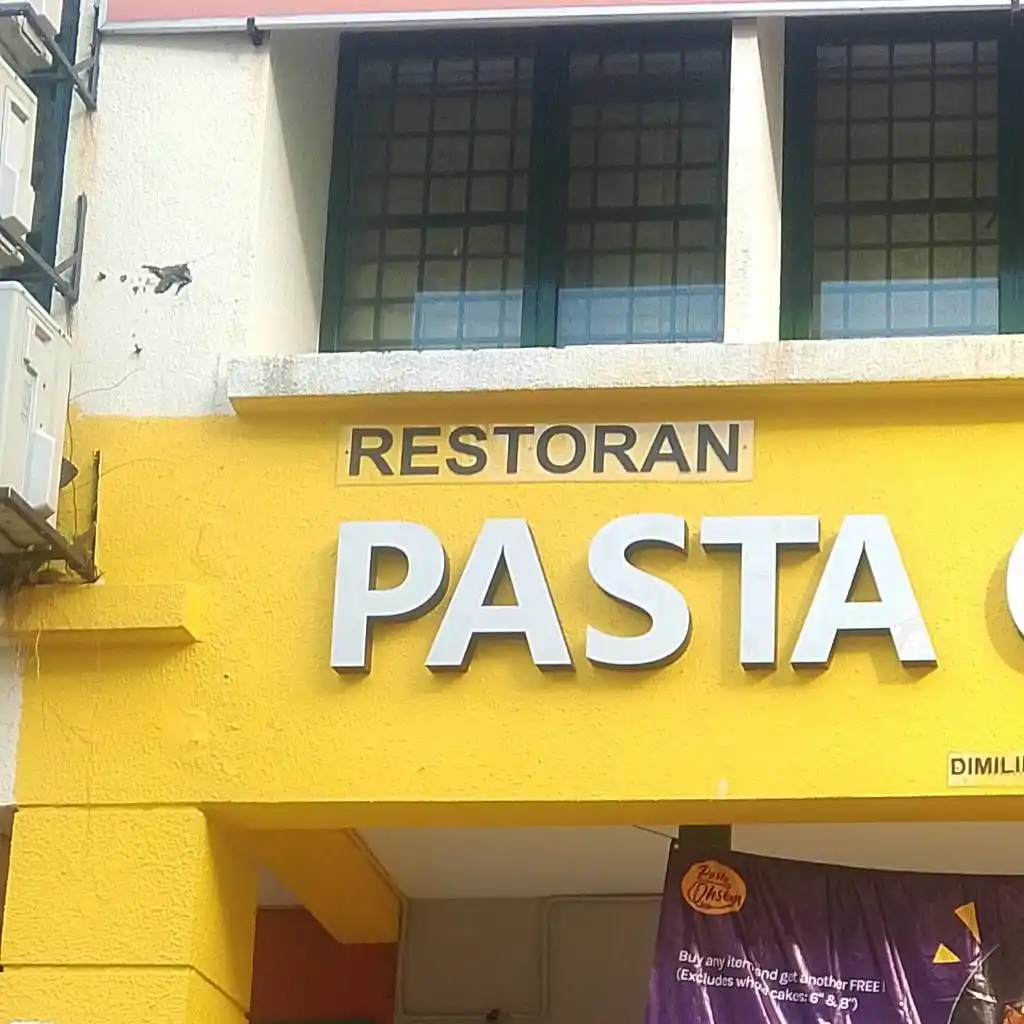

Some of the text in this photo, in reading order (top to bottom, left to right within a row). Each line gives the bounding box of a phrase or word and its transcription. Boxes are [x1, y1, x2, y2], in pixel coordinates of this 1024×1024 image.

[348, 424, 740, 477] RESTORAN
[331, 513, 938, 673] PASTA
[676, 967, 734, 988] (Excludes
[770, 988, 808, 1003] cakes:
[825, 997, 837, 1008] &
[679, 950, 701, 968] Buy
[705, 957, 725, 971] any
[755, 967, 778, 981] and
[779, 970, 798, 985] get
[799, 974, 848, 991] another
[850, 979, 880, 993] FREE
